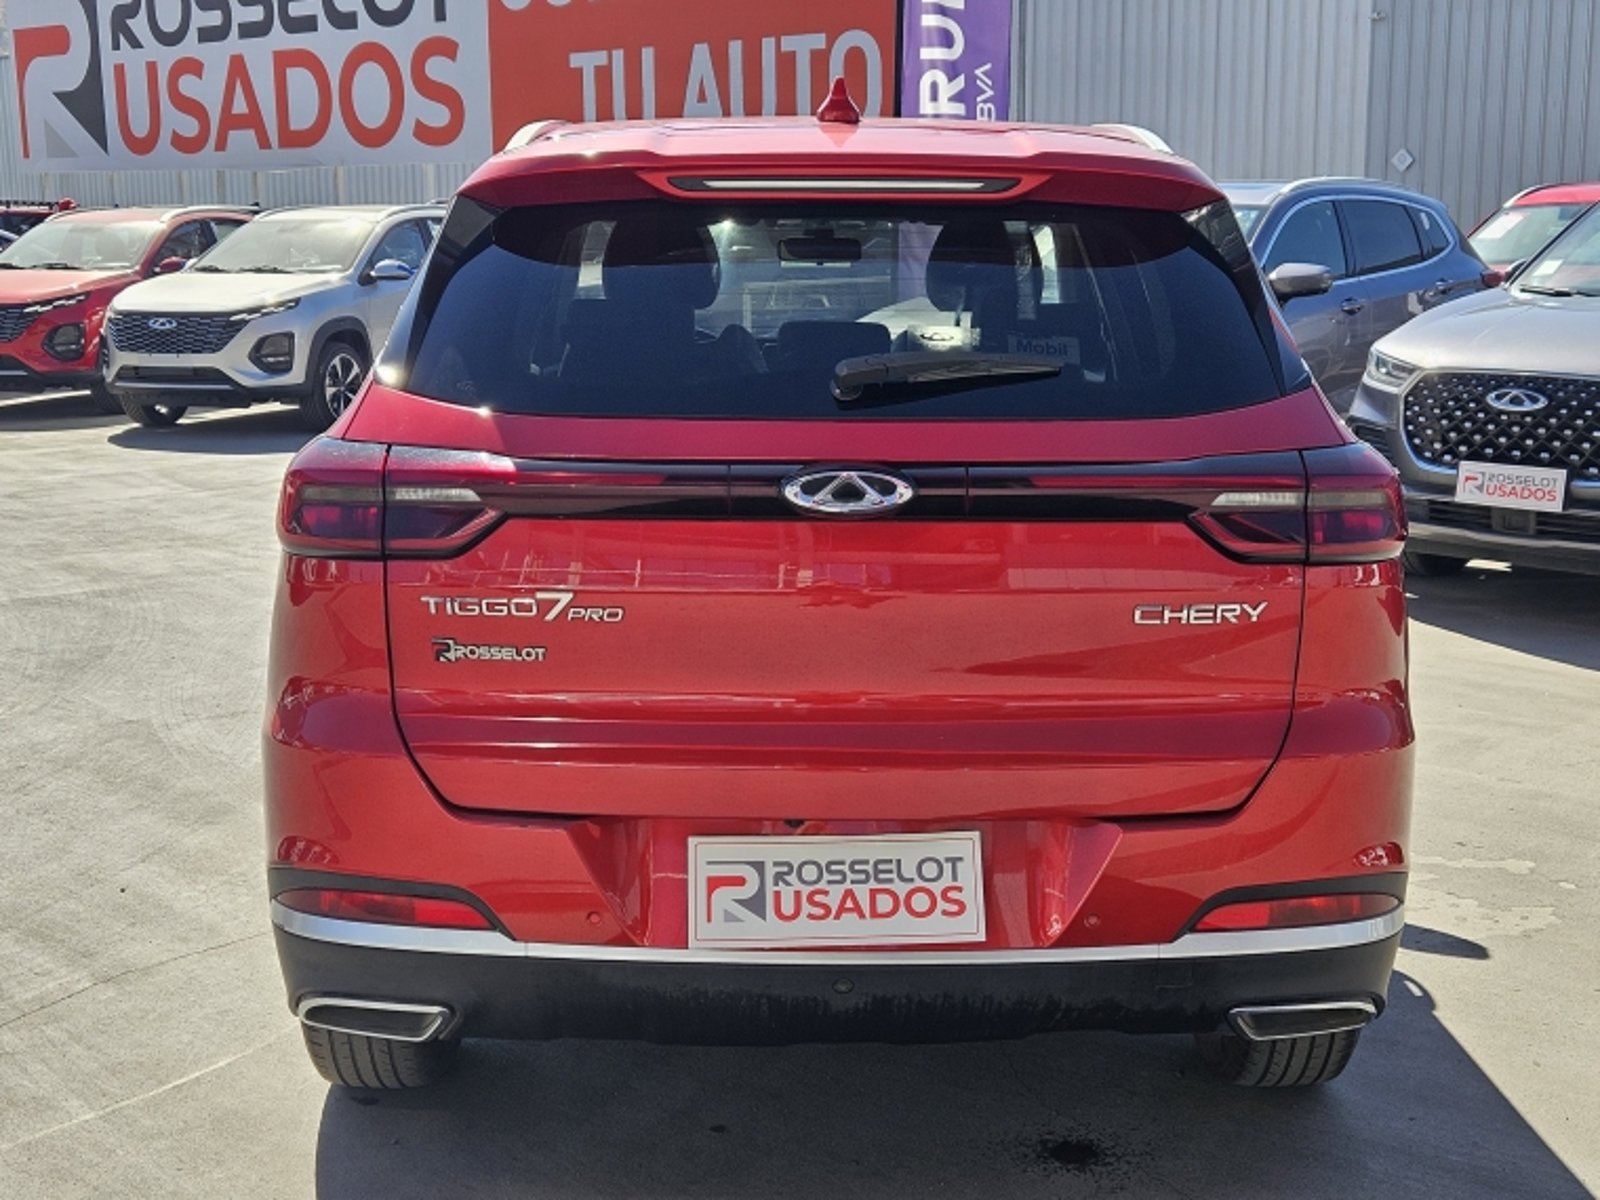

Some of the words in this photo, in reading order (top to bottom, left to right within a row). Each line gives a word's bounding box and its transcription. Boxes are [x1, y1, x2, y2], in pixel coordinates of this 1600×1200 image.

[110, 0, 447, 51] ROSS
[569, 46, 656, 123] TU
[682, 29, 884, 119] AUTO
[919, 0, 966, 117] RU
[113, 35, 466, 156] USADOS
[1486, 484, 1557, 502] USADOS
[1487, 472, 1558, 488] ROSSELOT
[1133, 600, 1269, 625] CHERY
[454, 645, 547, 662] ROSSELOT
[772, 856, 965, 888] ROSSELOT
[772, 885, 968, 923] USADOS
